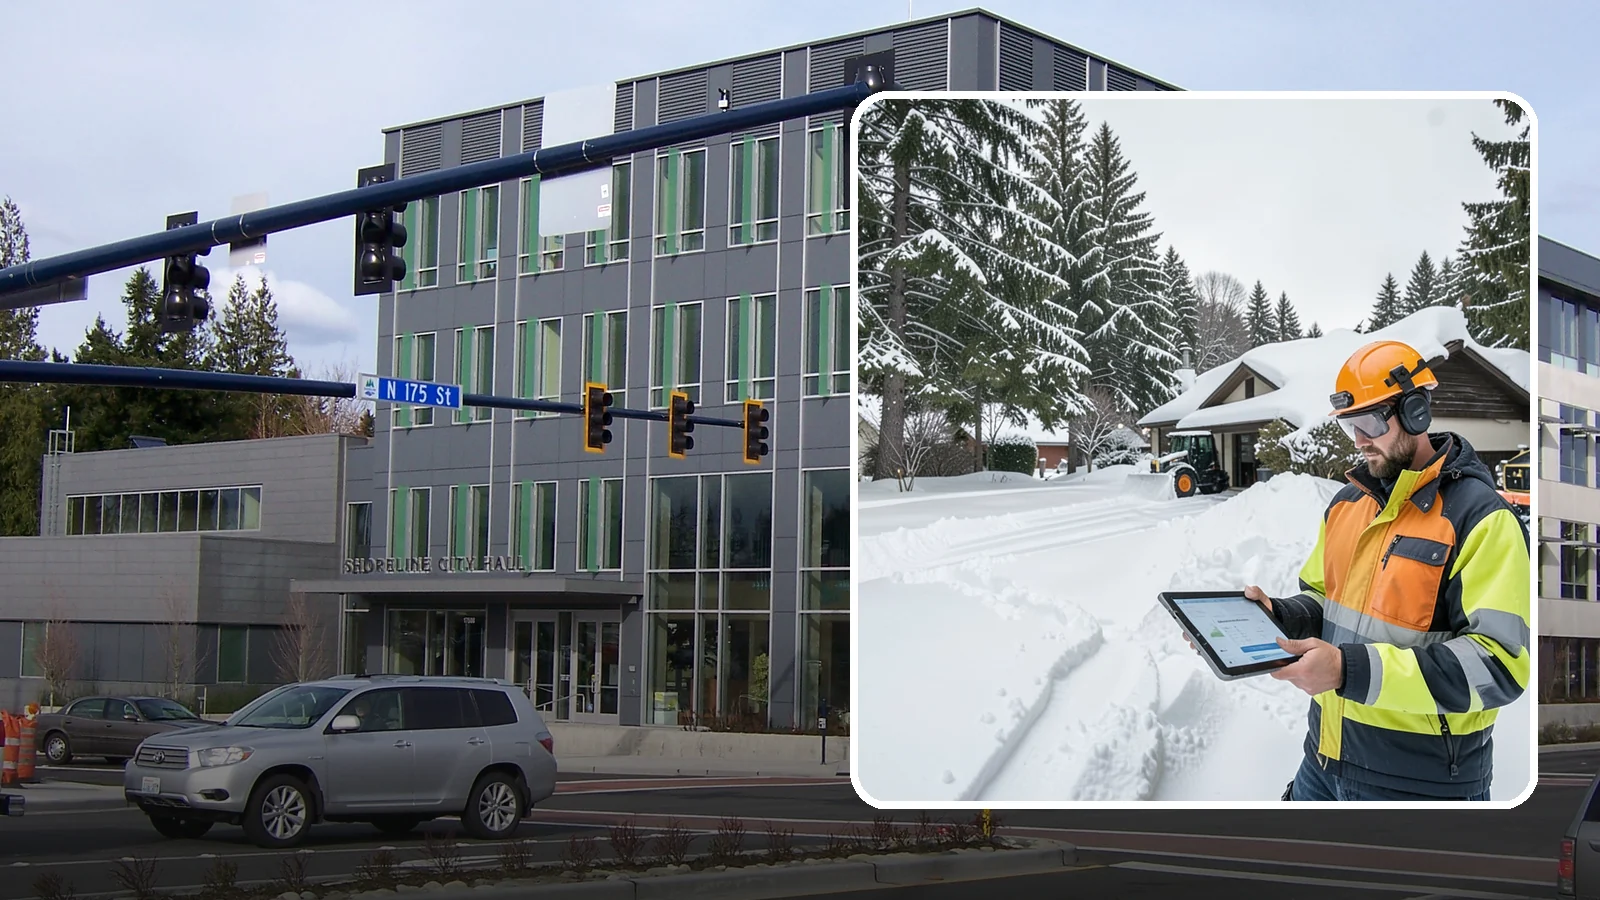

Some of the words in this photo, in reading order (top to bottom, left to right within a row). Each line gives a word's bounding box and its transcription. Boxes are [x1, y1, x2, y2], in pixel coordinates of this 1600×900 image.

[387, 381, 396, 399] N
[405, 382, 427, 403] 175
[436, 386, 451, 406] St
[343, 557, 432, 573] SHORELINE
[438, 556, 475, 572] CITY
[483, 556, 526, 571] HALL
